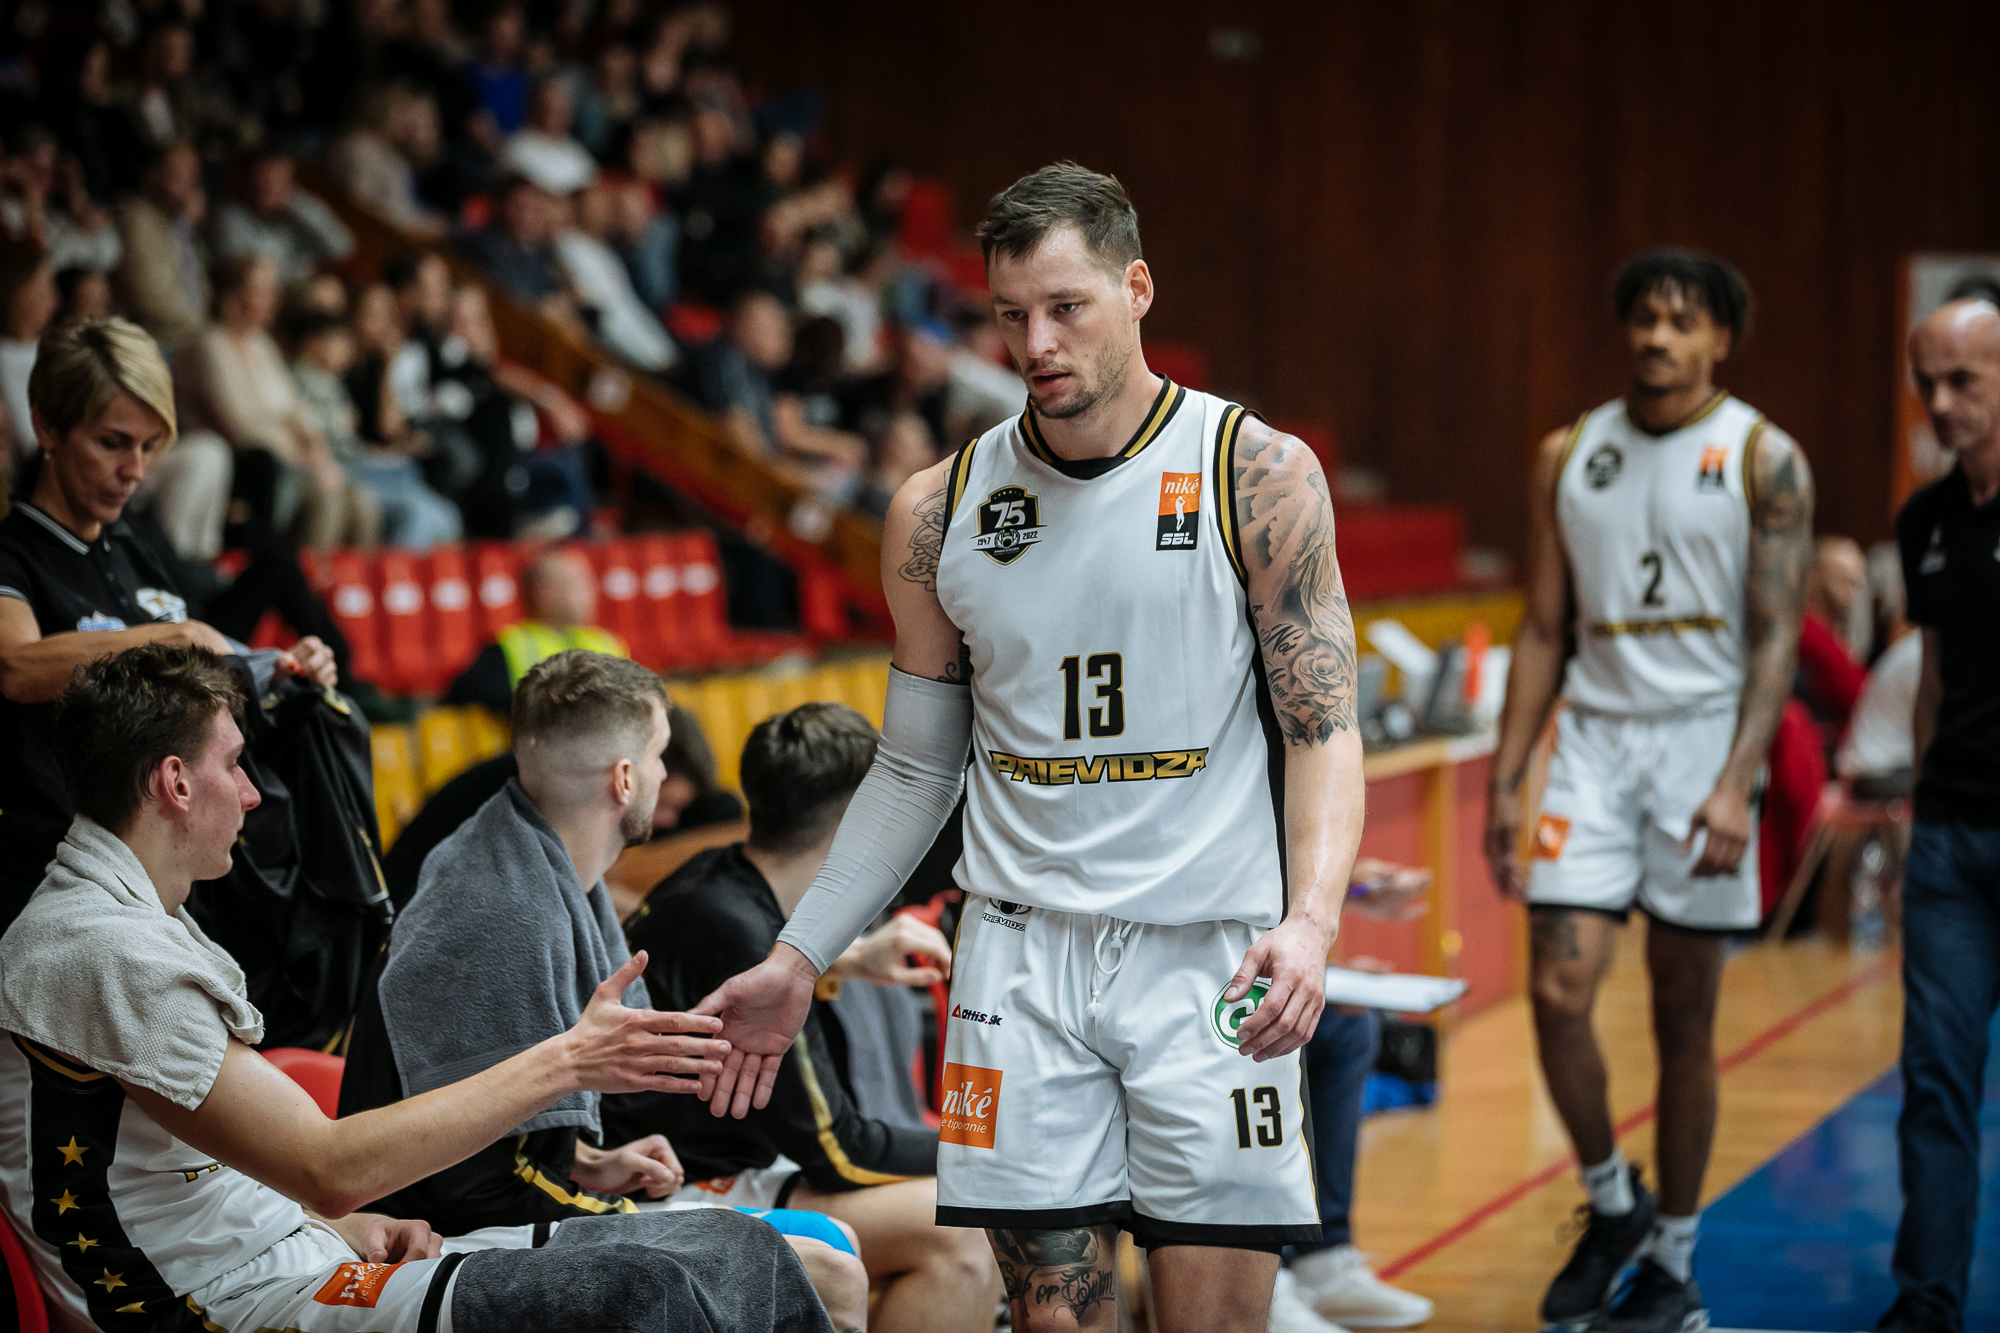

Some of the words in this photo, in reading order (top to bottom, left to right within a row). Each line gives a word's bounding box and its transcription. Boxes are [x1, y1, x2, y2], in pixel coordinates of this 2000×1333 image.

[1164, 477, 1200, 494] niké
[989, 499, 1026, 529] 75
[977, 537, 991, 546] 1947
[1022, 531, 1038, 540] 2022
[1160, 531, 1195, 546] SBL
[1641, 550, 1666, 607] 2
[1057, 651, 1126, 742] 13
[988, 747, 1209, 786] PRIEVIDZA
[941, 1081, 993, 1119] niké
[1228, 1085, 1284, 1150] 13
